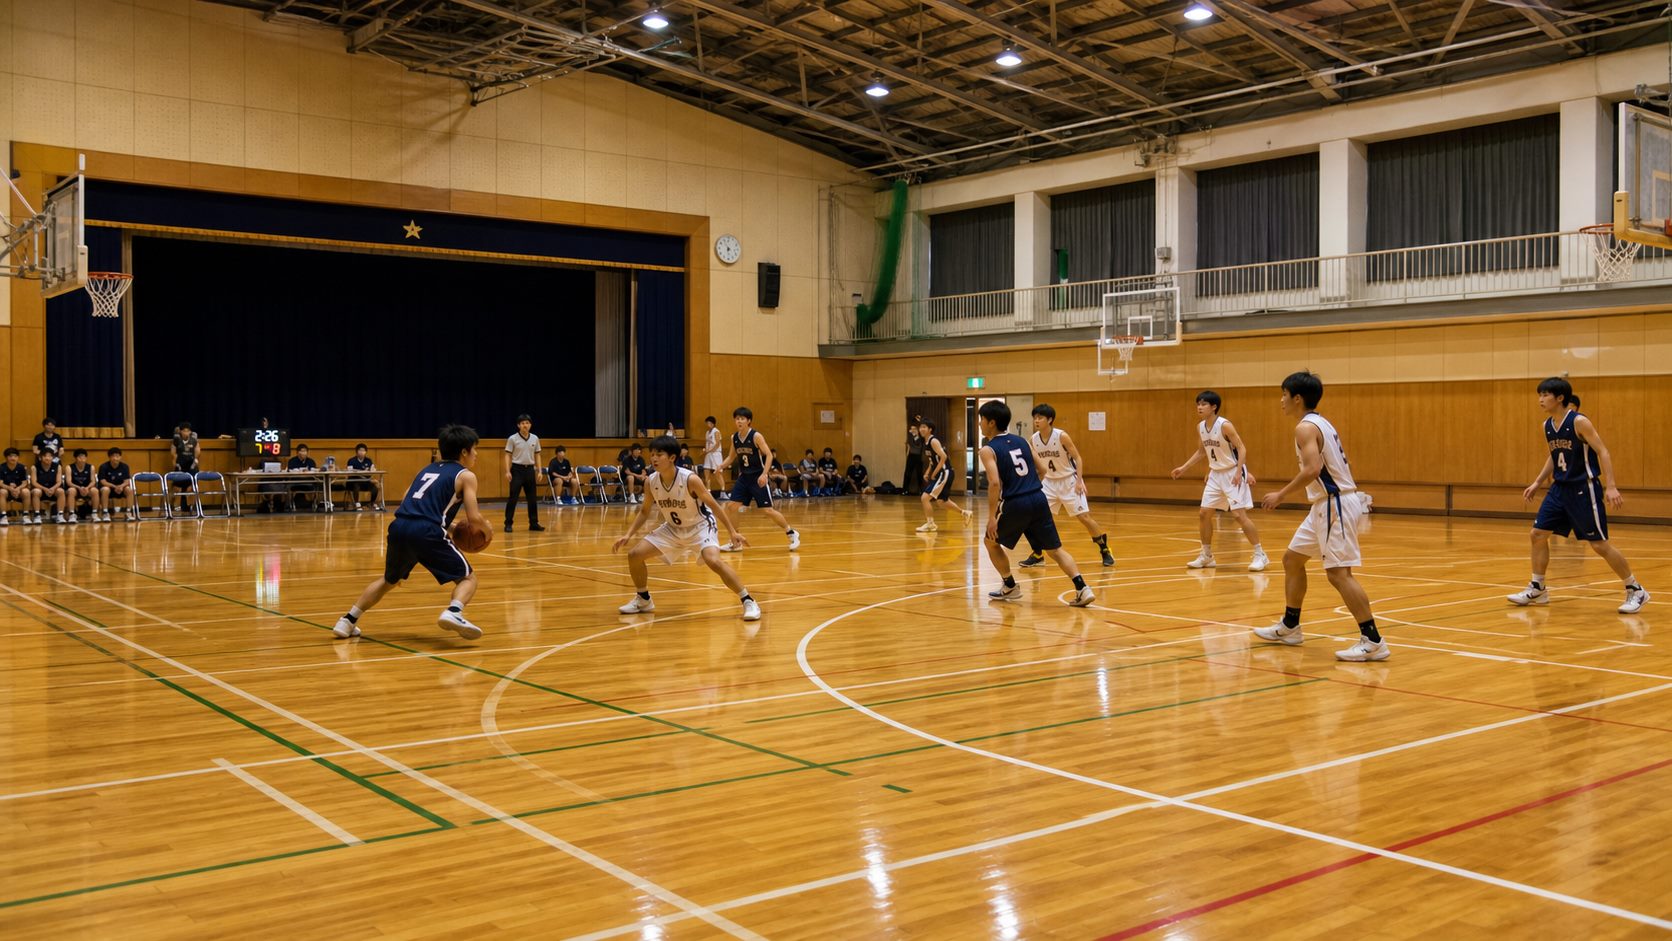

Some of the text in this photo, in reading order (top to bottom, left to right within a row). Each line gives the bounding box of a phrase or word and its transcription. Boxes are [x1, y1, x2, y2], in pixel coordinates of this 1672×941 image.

[255, 430, 279, 442] 2:26
[255, 443, 262, 454] 7
[272, 443, 281, 455] 8
[1211, 448, 1218, 462] 4
[742, 454, 750, 467] 3
[1009, 448, 1029, 477] 5
[1048, 460, 1057, 472] 4
[1557, 452, 1567, 472] 4
[412, 472, 440, 499] 7
[670, 511, 682, 526] 6
